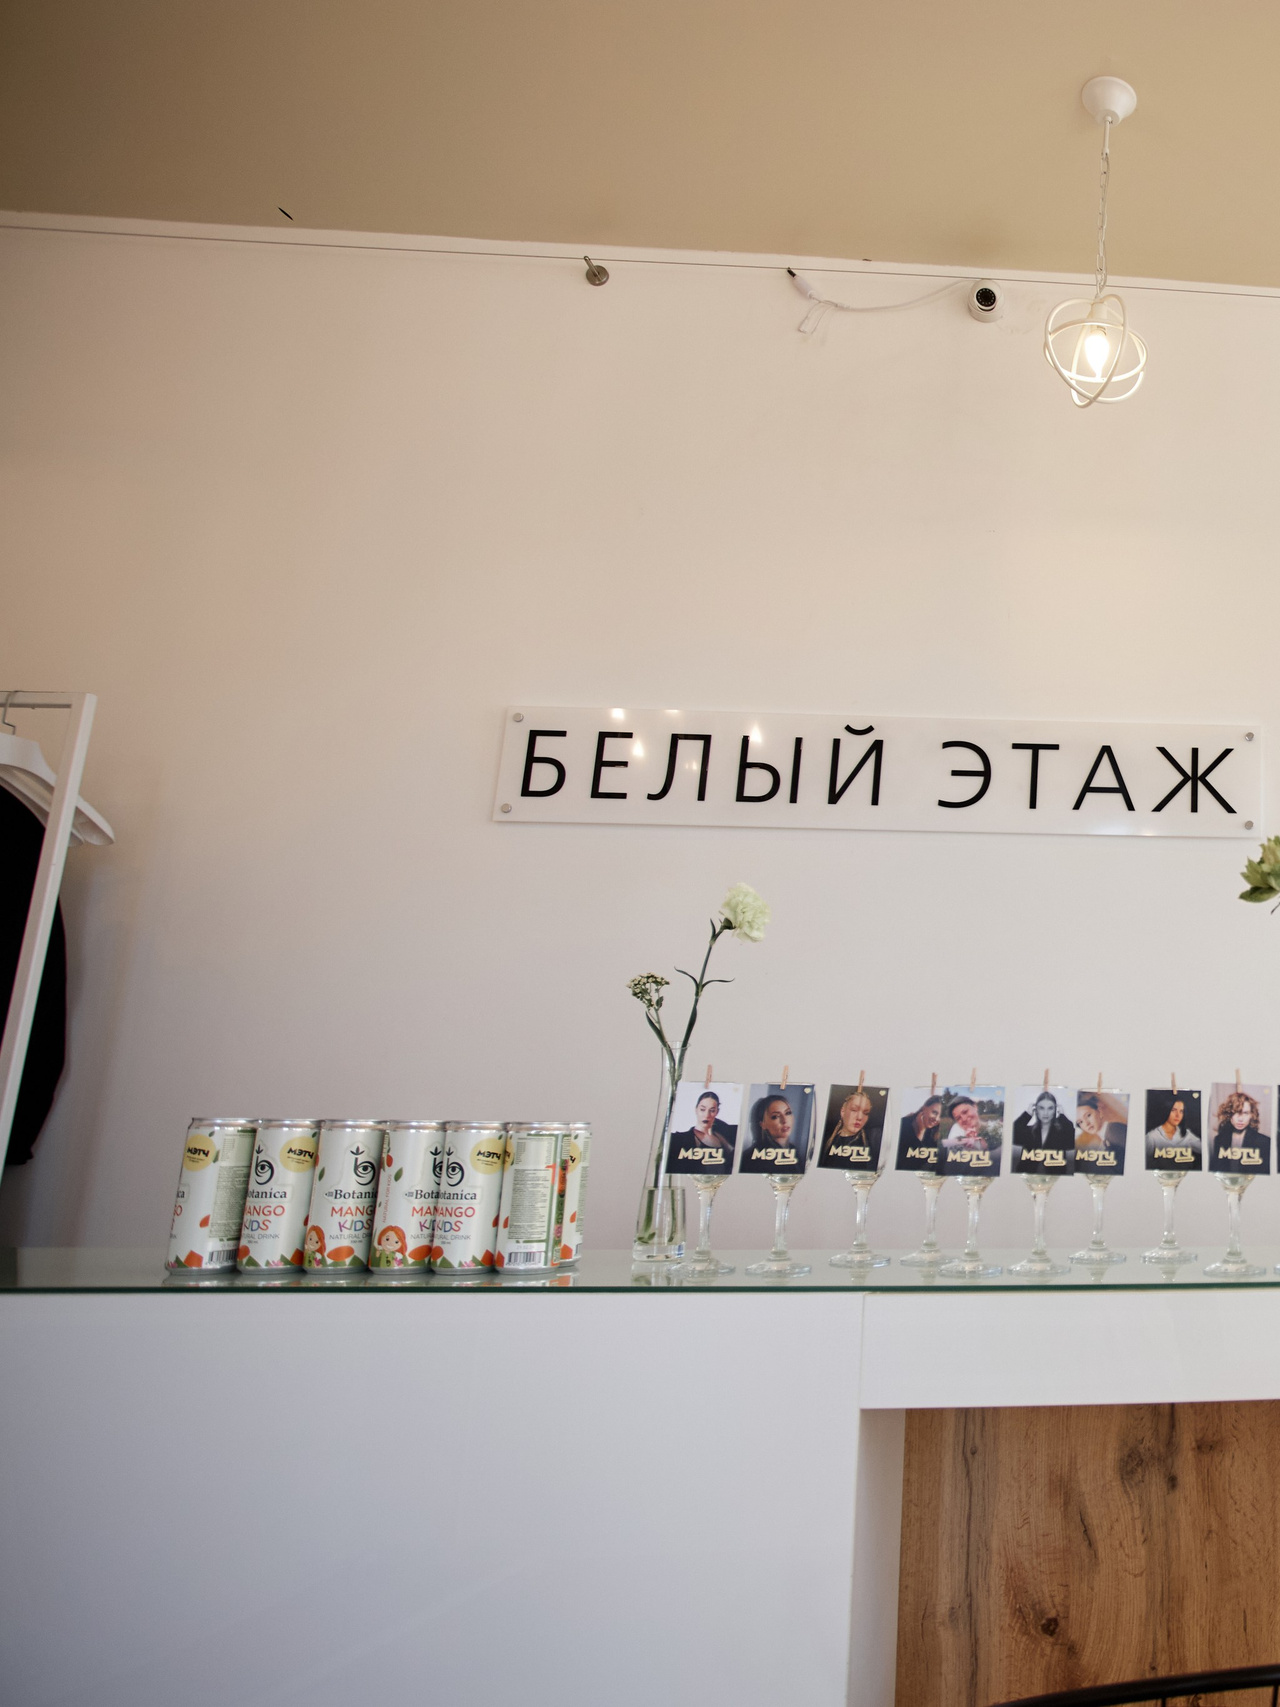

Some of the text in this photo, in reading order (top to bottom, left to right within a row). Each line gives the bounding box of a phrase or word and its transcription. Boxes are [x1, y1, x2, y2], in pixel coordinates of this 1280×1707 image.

[519, 724, 1238, 814] БЕЛЫЙ ЭТАЖ
[906, 1147, 938, 1160] МЭТ
[248, 1187, 287, 1199] otanica
[415, 1189, 440, 1200] Bota
[441, 1189, 477, 1200] otanica
[331, 1205, 374, 1217] MANG
[411, 1205, 437, 1217] MAN
